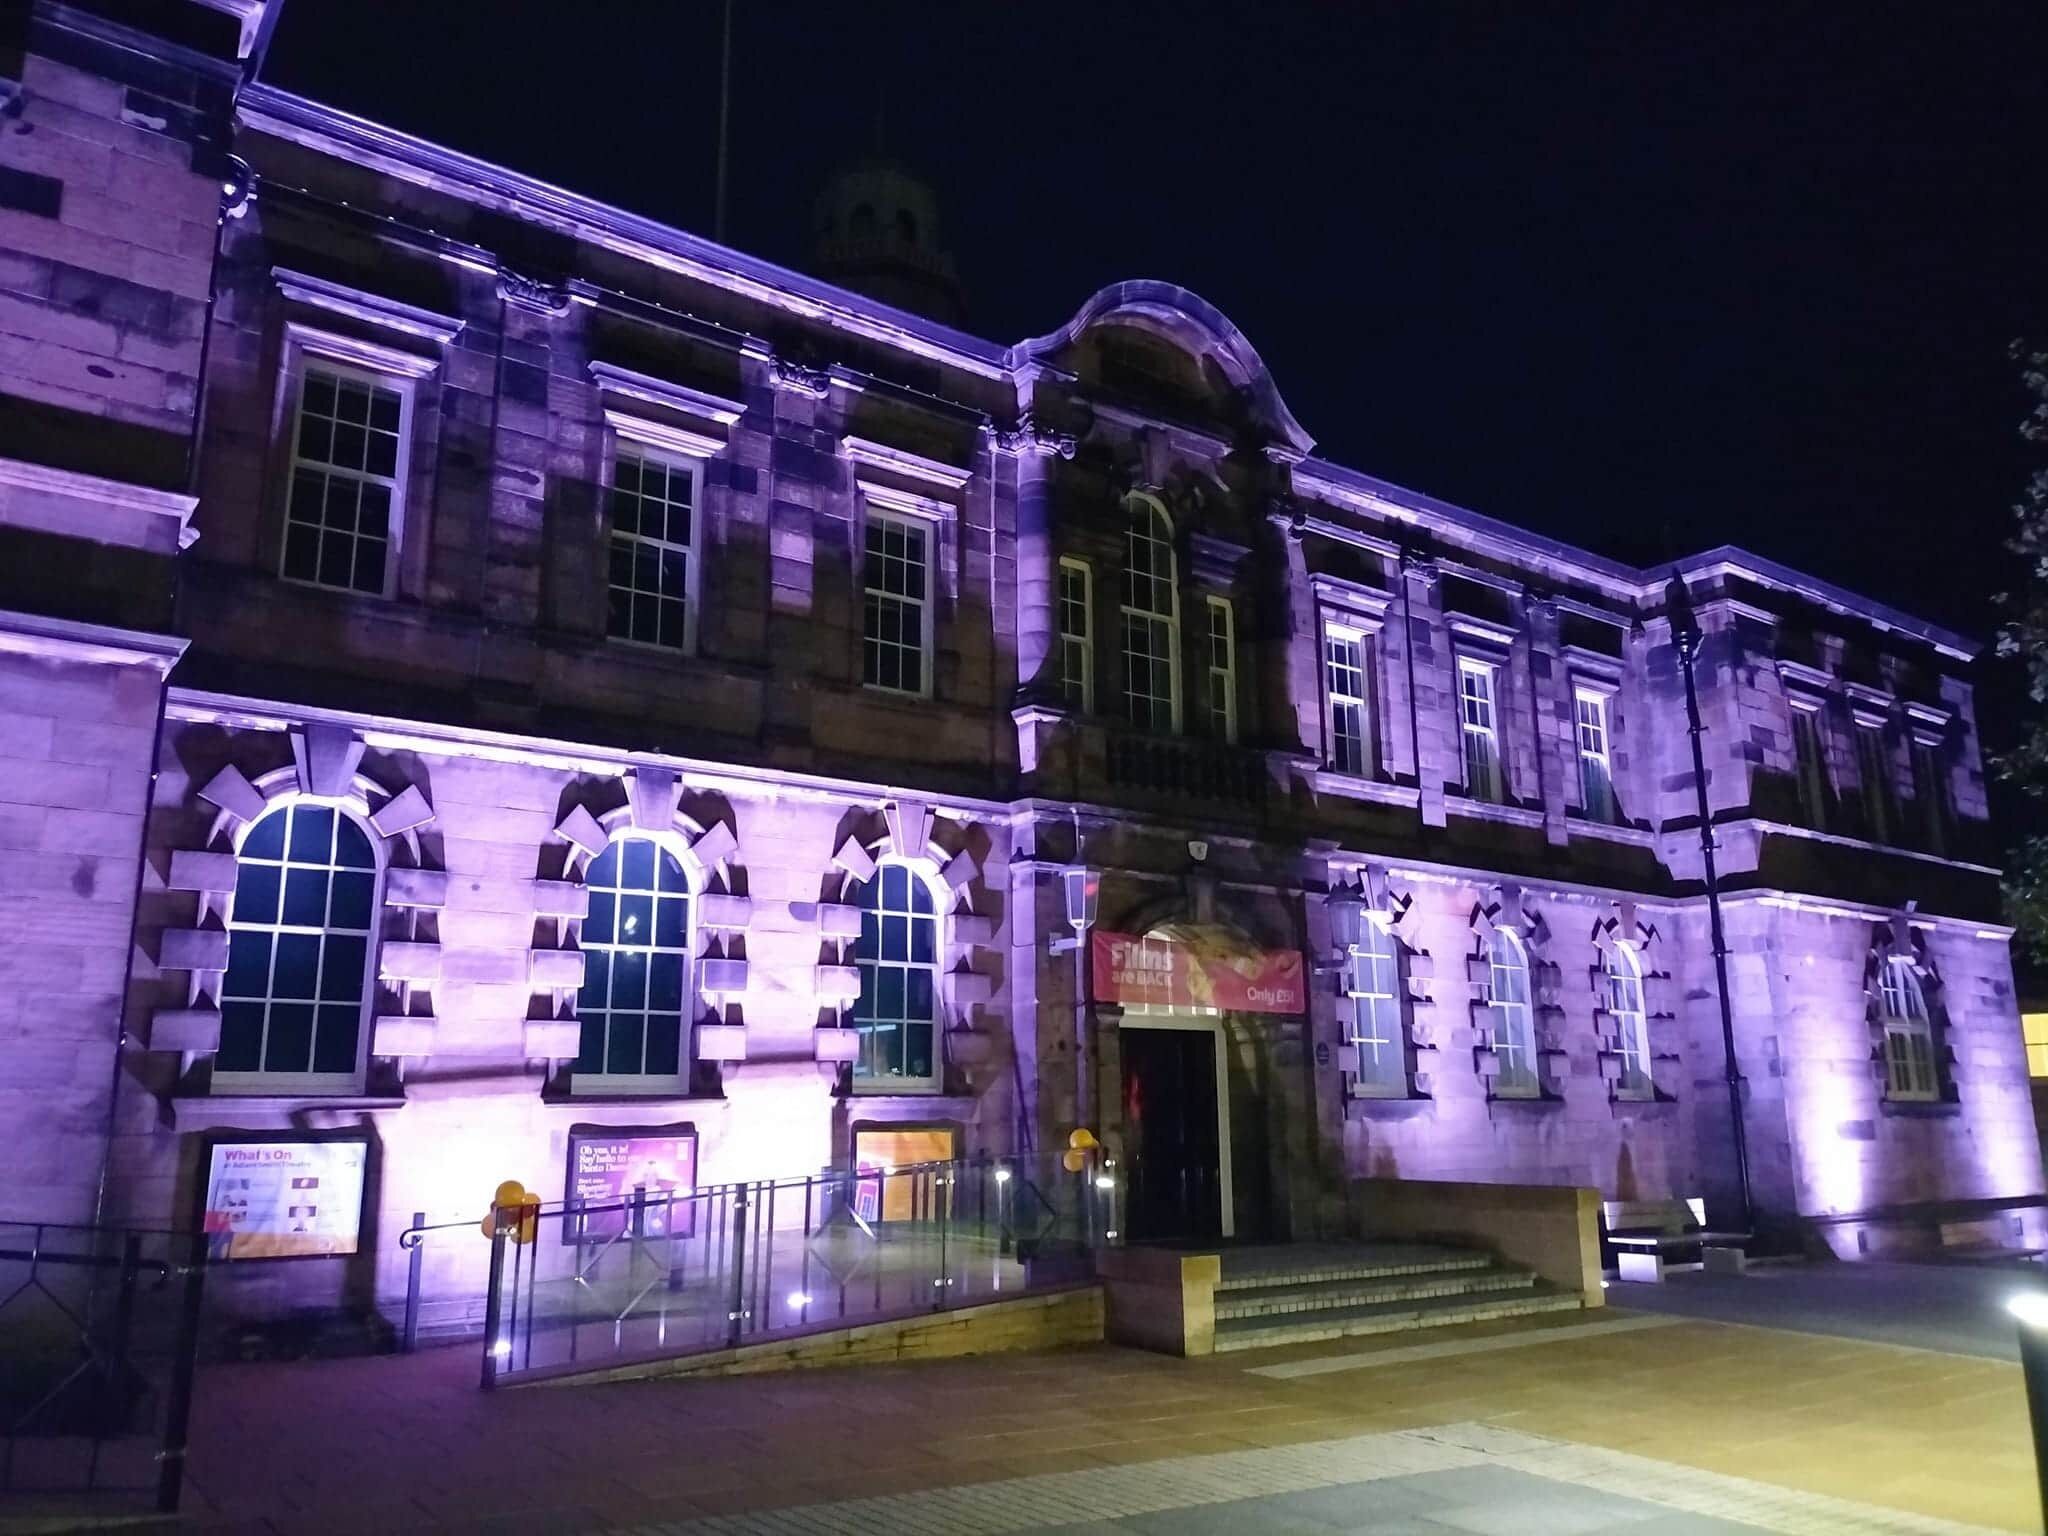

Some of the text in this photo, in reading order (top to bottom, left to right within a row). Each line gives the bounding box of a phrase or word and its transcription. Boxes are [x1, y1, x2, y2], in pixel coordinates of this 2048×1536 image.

[1112, 942, 1173, 971] Films
[1112, 971, 1173, 986] are BACK
[1247, 985, 1275, 1006] Only
[224, 1149, 292, 1161] What's On
